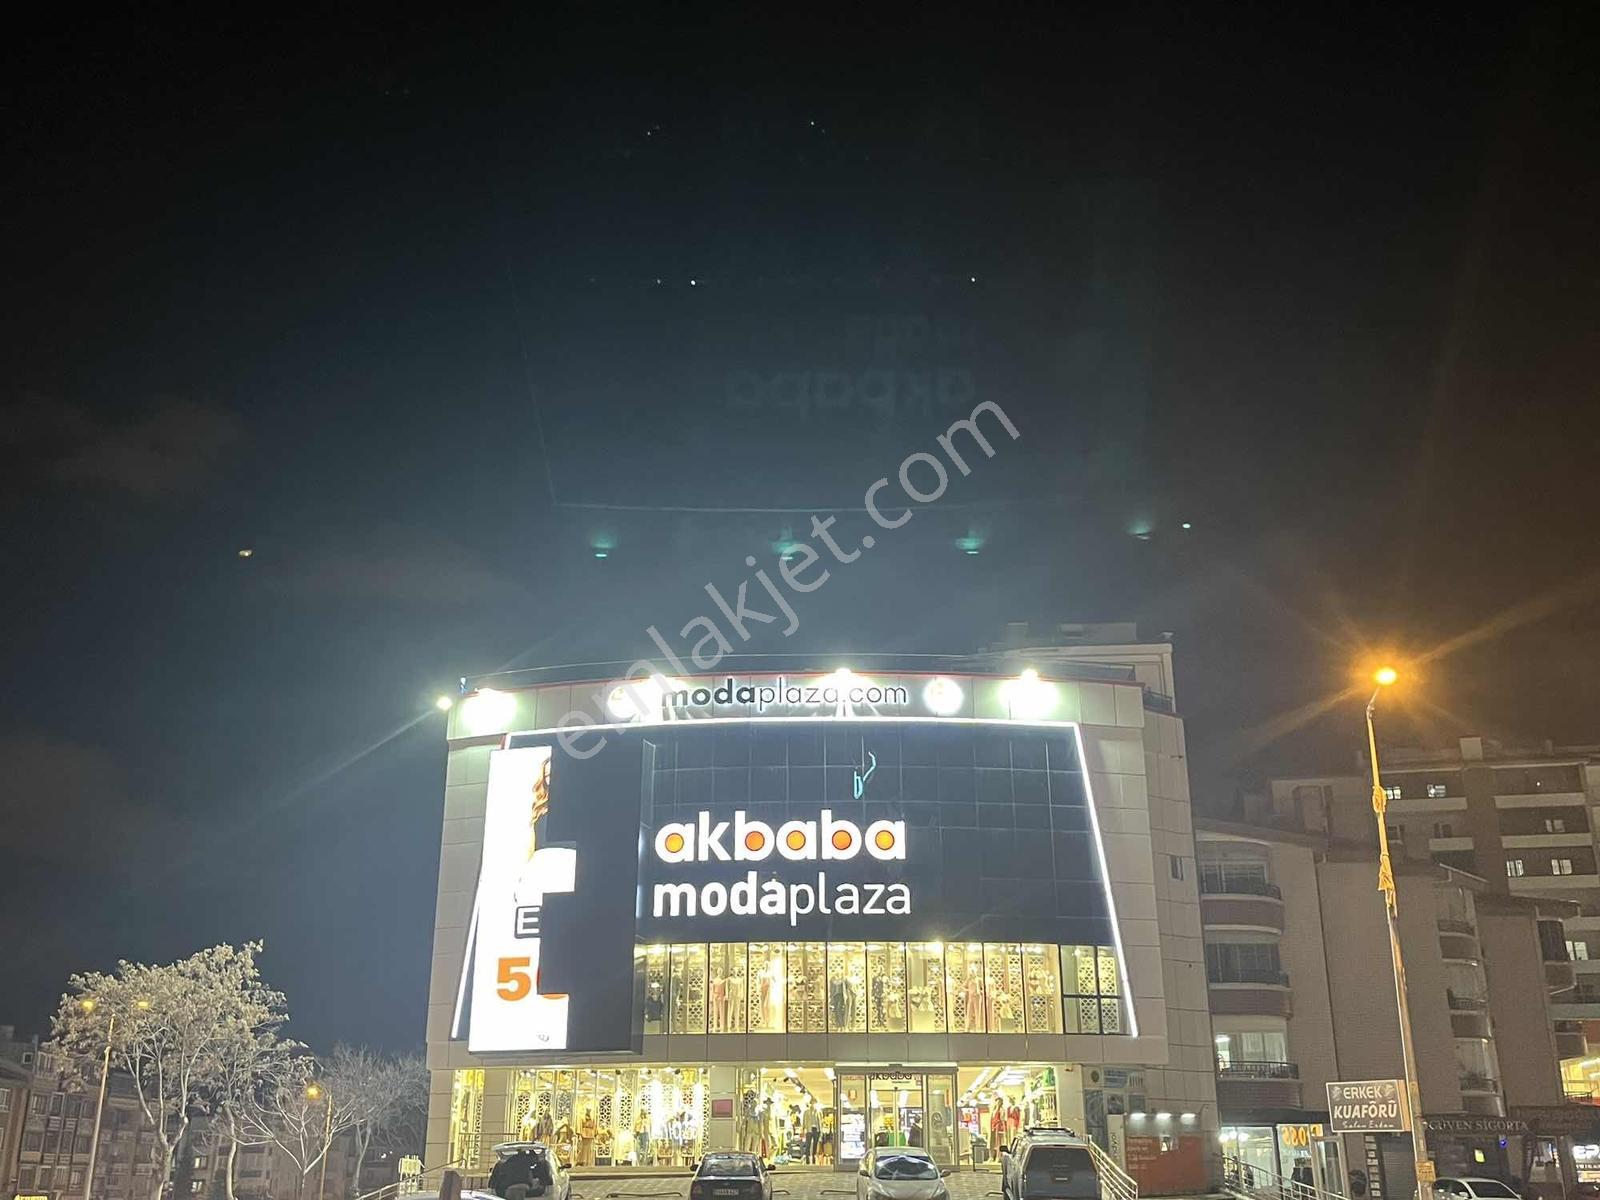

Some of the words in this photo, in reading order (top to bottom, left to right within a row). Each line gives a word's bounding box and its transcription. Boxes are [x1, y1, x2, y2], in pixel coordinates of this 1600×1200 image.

[661, 677, 907, 712] modaplaza.com
[654, 809, 906, 863] akbaba
[653, 870, 911, 926] modaplaza
[1343, 1086, 1383, 1099] ERKEK
